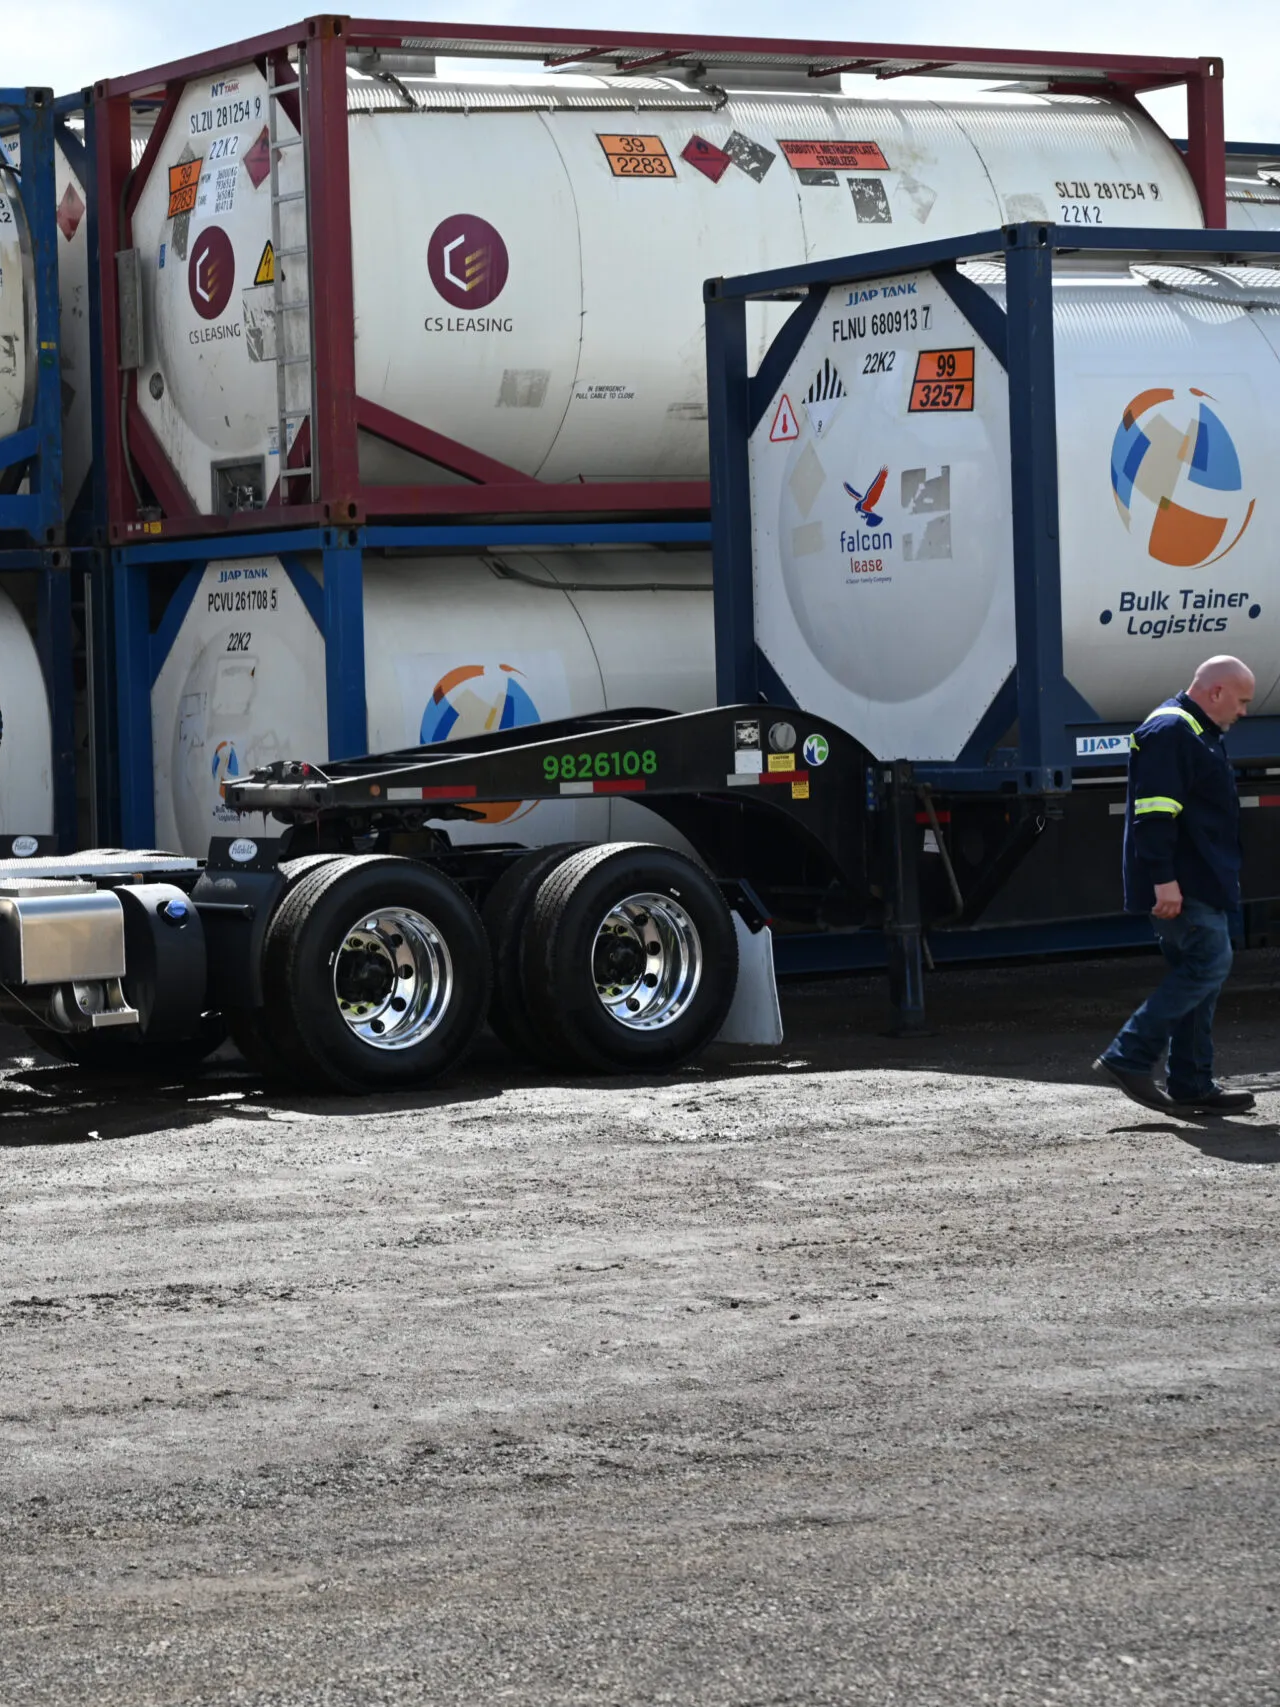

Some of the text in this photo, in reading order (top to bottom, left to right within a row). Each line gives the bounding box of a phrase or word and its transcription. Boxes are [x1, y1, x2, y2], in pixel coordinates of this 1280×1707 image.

[211, 82, 225, 98] NT
[190, 97, 261, 134] SLZU 281254 9
[209, 136, 239, 160] 22K2
[619, 137, 646, 153] 39
[617, 157, 667, 174] 2283
[816, 155, 858, 166] STABILIZED
[171, 188, 193, 214] 2283
[1055, 182, 1159, 200] SLZU 281254 9
[1061, 205, 1103, 224] 22K2
[845, 282, 917, 306] JJAP TANK
[189, 323, 241, 345] CS LEASING
[424, 318, 513, 332] CS LEASING
[833, 306, 930, 343] FLNU 680913 7
[862, 351, 896, 375] 22K2
[936, 354, 955, 377] 99
[919, 384, 964, 408] 3257
[840, 529, 892, 553] falcon
[218, 568, 268, 583] JJAP TANK
[850, 557, 882, 574] lease
[208, 589, 277, 612] PCVU 261708 5
[1119, 589, 1248, 613] Bulk Tainer
[1126, 614, 1228, 639] Logistics
[227, 632, 252, 652] 22K2
[1078, 737, 1122, 753] JJAP
[543, 750, 657, 780] 9826108
